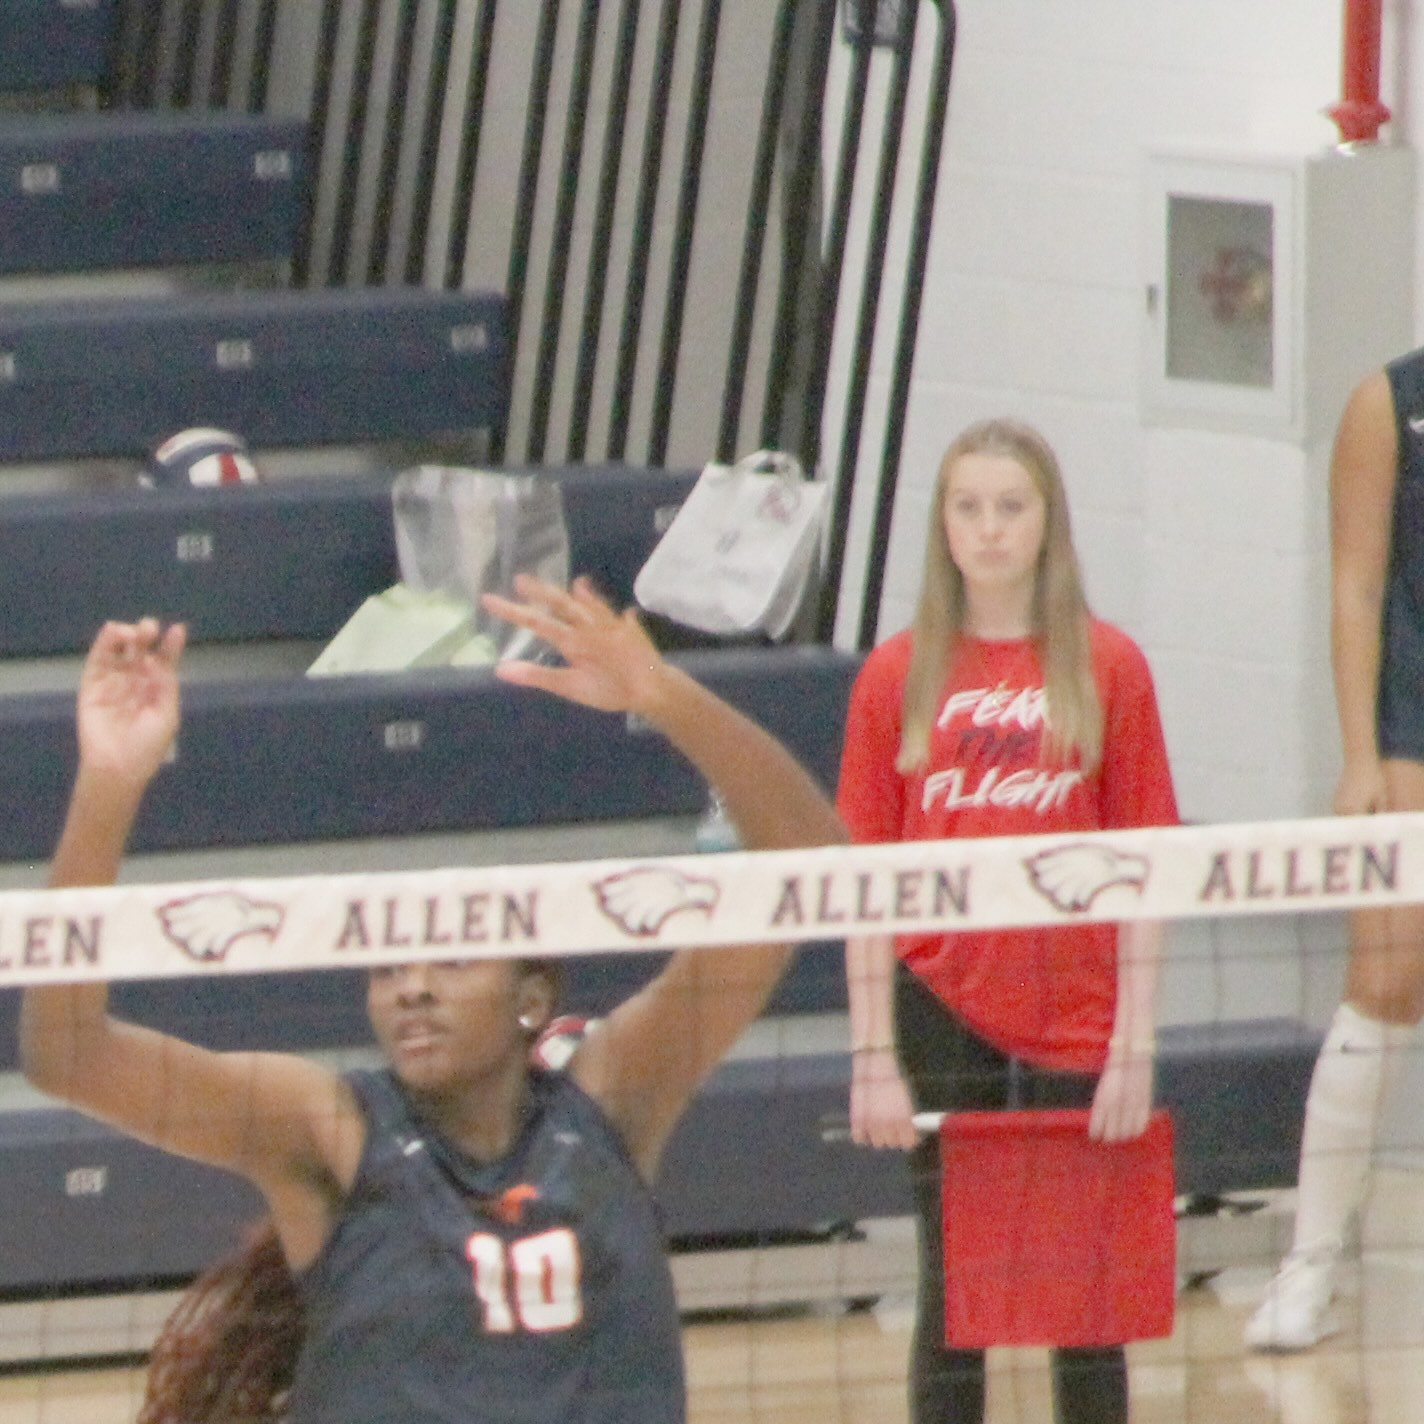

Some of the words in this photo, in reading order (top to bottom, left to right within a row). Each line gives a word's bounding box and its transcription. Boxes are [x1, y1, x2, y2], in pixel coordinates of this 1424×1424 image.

[921, 766, 1084, 816] FLIGHT
[336, 888, 542, 951] ALLEN
[769, 865, 972, 926] ALLEN
[1198, 842, 1404, 902] ALLEN
[465, 1227, 583, 1333] 10
